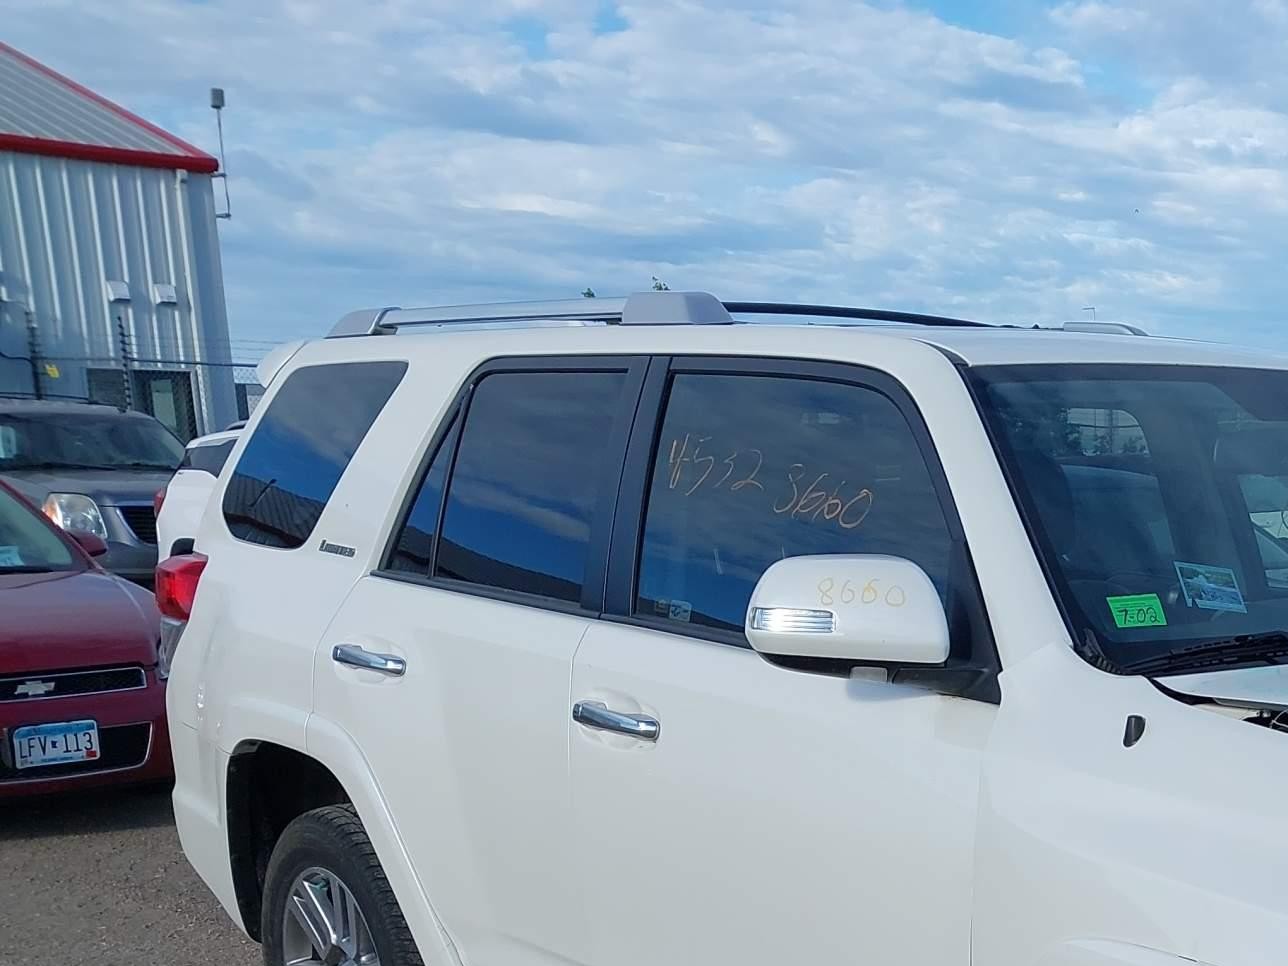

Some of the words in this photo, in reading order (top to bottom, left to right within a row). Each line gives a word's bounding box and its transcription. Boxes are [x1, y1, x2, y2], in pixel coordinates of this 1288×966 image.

[817, 577, 905, 607] 8660
[19, 735, 47, 759] LFV
[63, 731, 94, 753] 113
